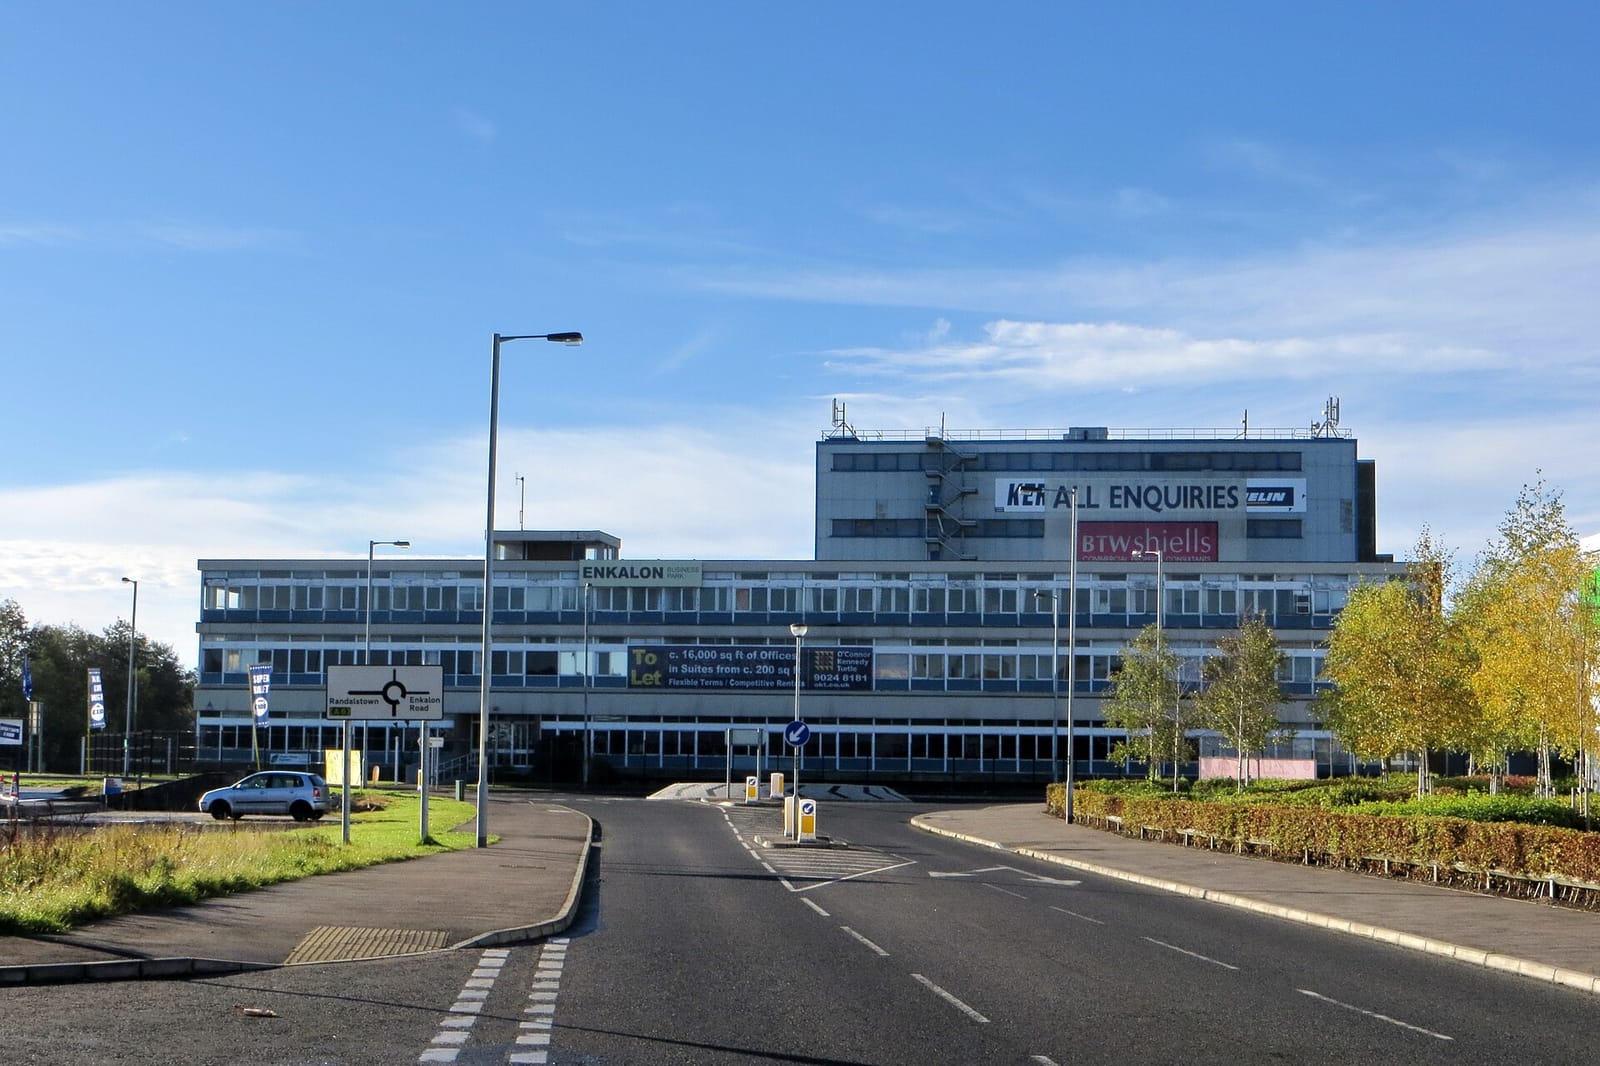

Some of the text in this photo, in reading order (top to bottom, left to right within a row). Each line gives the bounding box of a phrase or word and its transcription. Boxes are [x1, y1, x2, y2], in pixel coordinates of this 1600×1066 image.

[1110, 485, 1238, 513] ENQUIRIES
[583, 566, 664, 579] ENKALON
[632, 649, 657, 665] To
[682, 650, 717, 661] 16,000
[720, 652, 733, 661] sq
[735, 650, 744, 659] ft
[746, 651, 757, 659] of
[760, 651, 798, 660] Offices
[681, 665, 714, 674] Suites
[717, 665, 740, 674] from
[755, 665, 775, 674] 200
[778, 667, 790, 677] sq
[631, 670, 661, 686] Let
[729, 679, 775, 688] Competitive
[409, 696, 441, 704] Enkalon
[409, 704, 429, 712] Road
